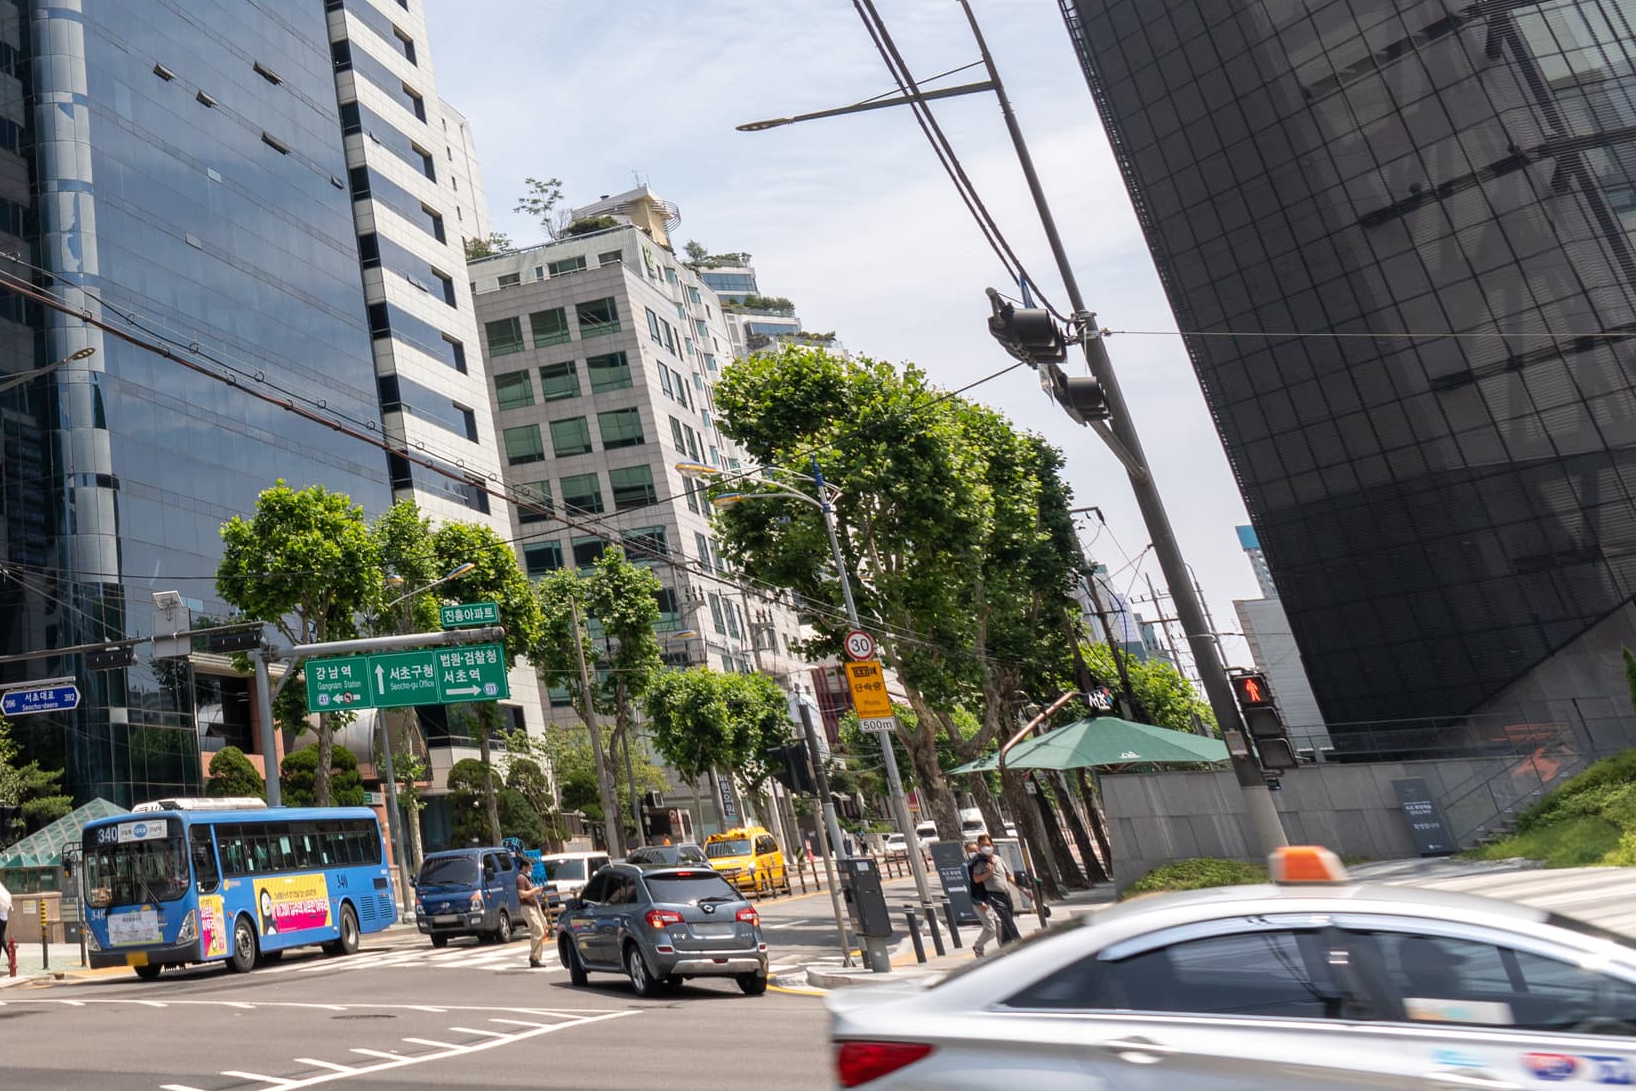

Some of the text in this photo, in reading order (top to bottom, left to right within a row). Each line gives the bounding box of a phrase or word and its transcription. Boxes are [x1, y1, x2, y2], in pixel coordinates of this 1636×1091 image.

[445, 607, 495, 623] 진흥아파트
[850, 638, 870, 653] 30
[315, 664, 352, 680] 강남역
[389, 663, 434, 680] 서초구청
[444, 667, 481, 684] 서초역
[389, 679, 435, 691] Seocho-gu Office
[24, 690, 55, 703] 서초대로
[863, 720, 893, 730] 500m
[98, 826, 119, 843] 340
[336, 873, 349, 890] 340
